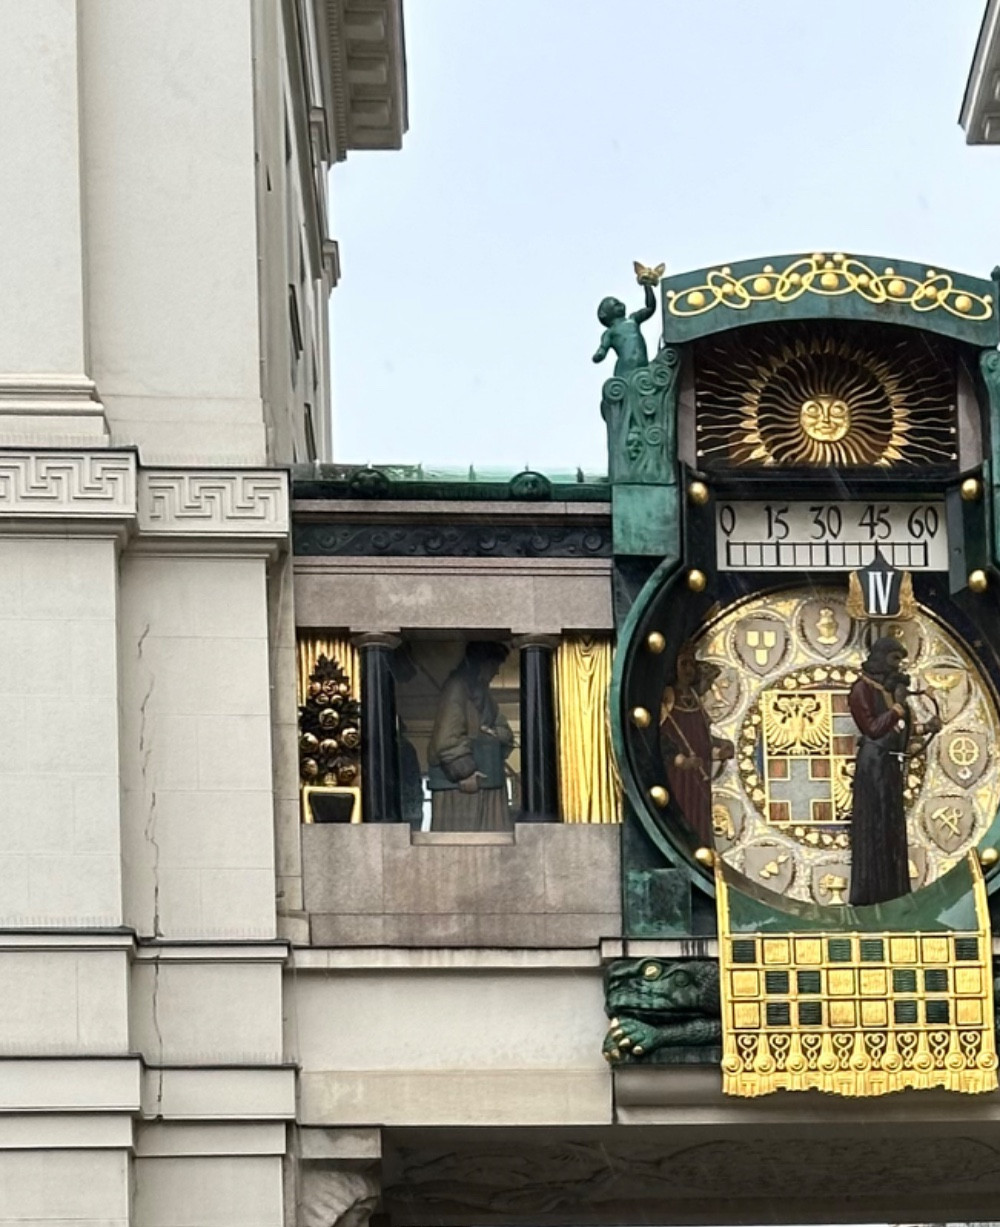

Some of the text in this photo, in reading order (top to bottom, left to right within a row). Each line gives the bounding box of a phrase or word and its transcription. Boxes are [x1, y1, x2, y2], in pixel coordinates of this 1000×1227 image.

[719, 504, 939, 540] 0 15 30 45 60
[867, 571, 895, 615] IV
